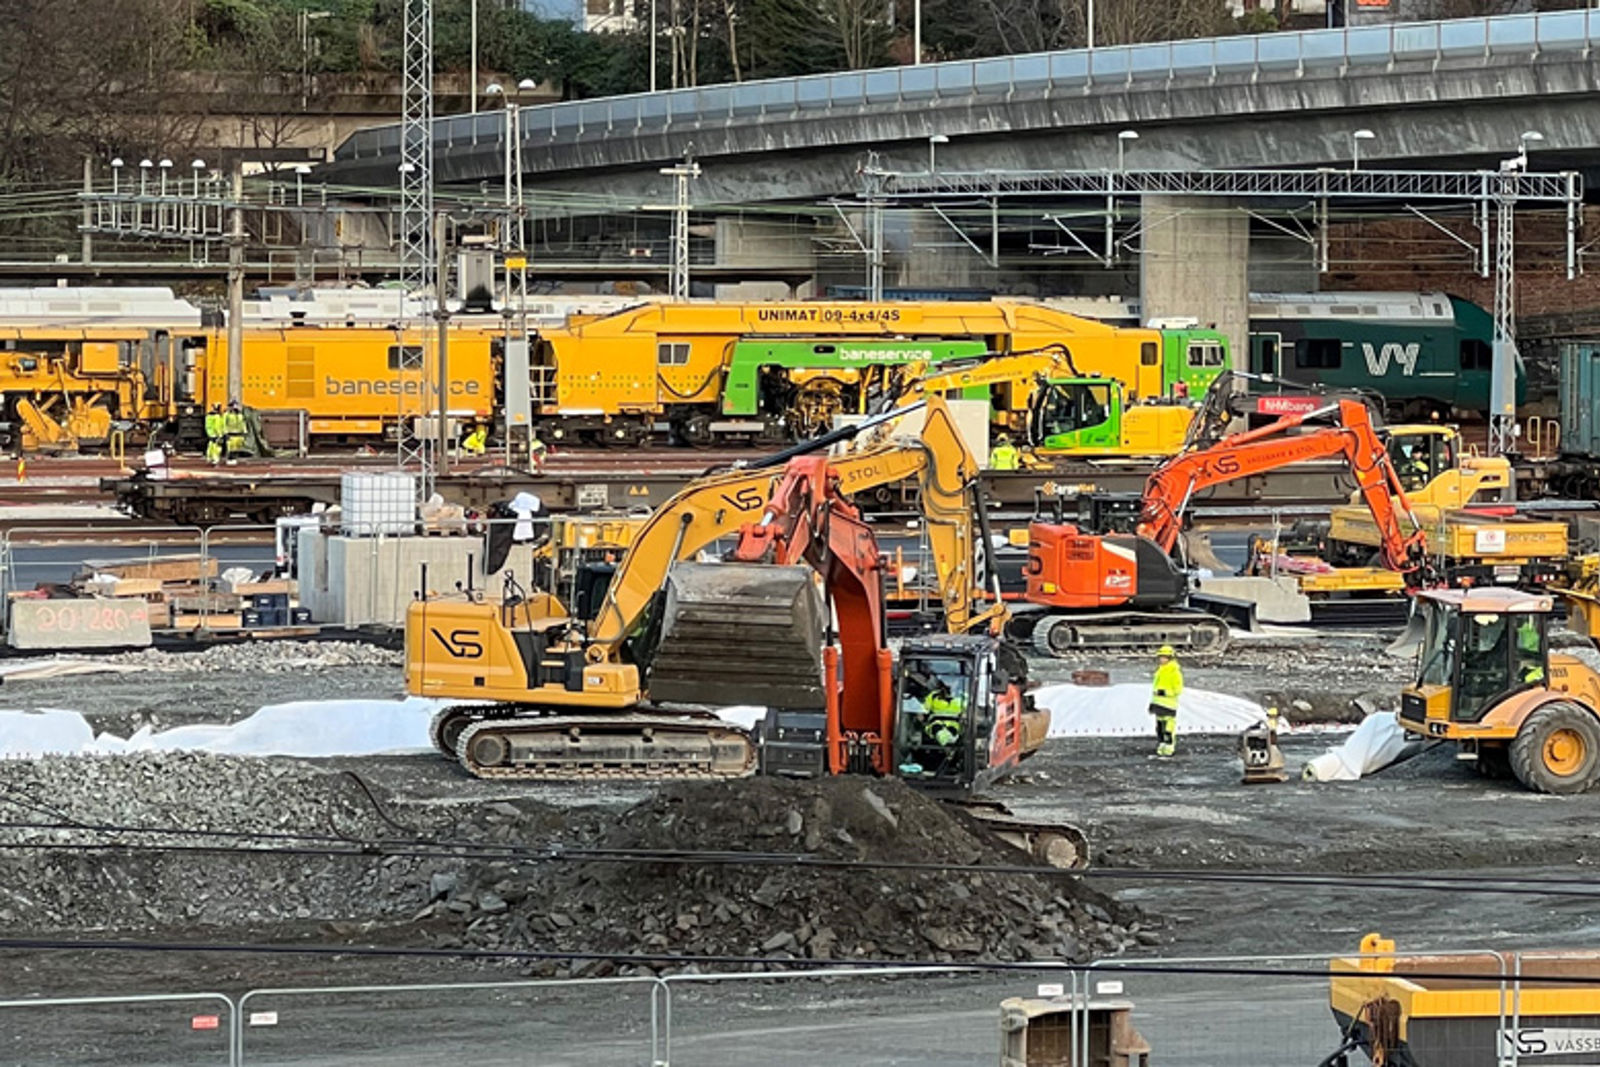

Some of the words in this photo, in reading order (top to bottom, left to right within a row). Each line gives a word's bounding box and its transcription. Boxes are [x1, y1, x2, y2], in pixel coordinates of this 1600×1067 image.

[758, 309, 817, 322] UNIMAT
[823, 309, 901, 322] 09-4x4/4S
[839, 348, 933, 361] baneservice
[847, 466, 883, 484] STOL
